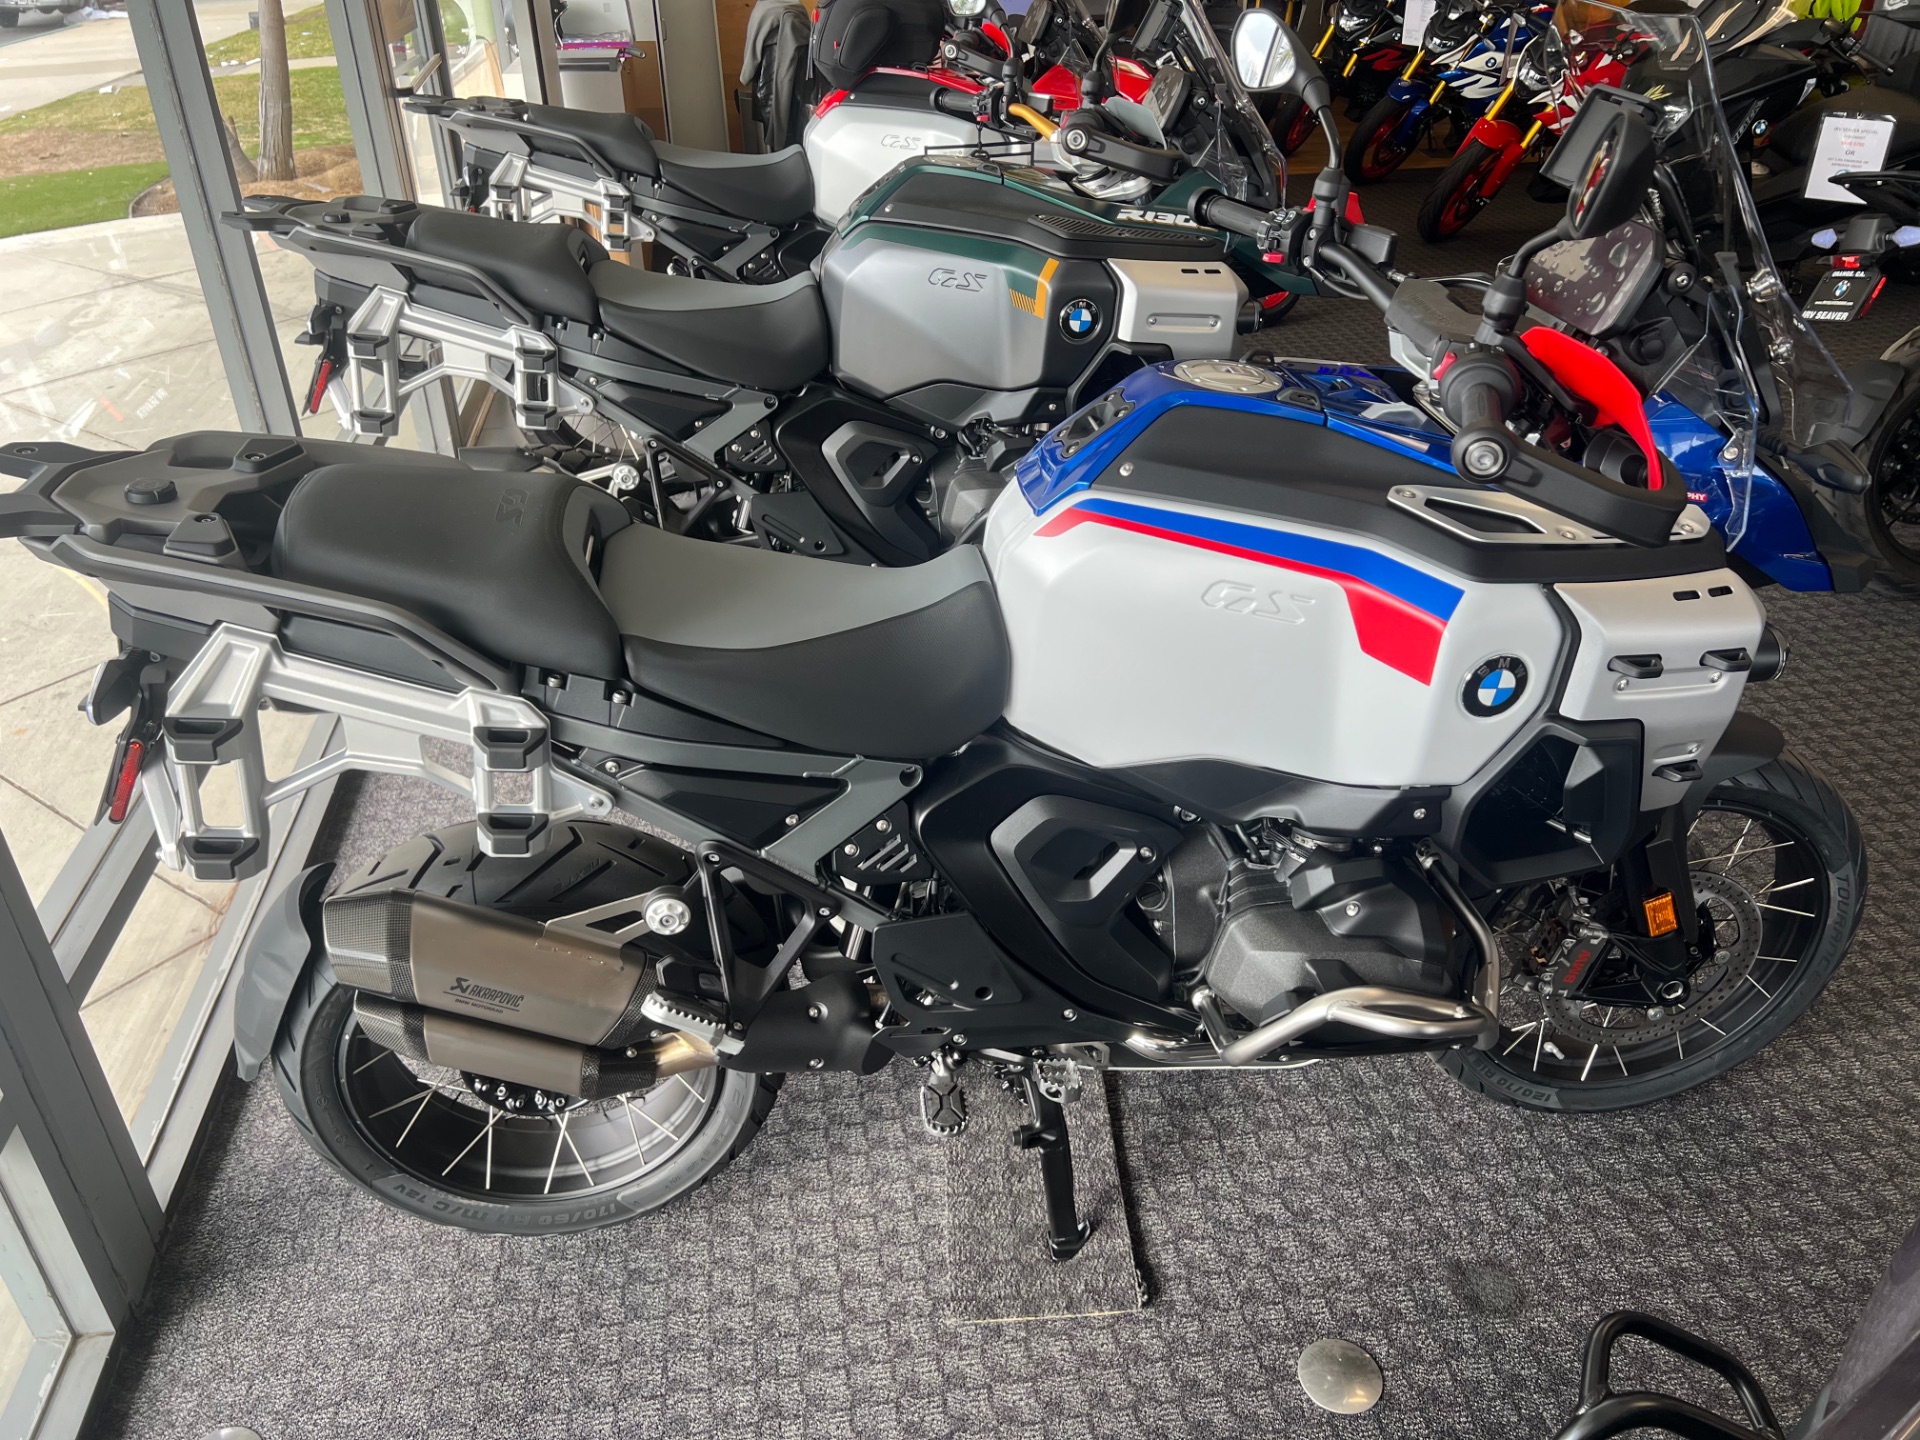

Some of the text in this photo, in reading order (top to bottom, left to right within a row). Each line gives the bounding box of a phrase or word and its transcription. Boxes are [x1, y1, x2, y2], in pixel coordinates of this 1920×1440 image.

[881, 134, 921, 151] GS
[928, 267, 988, 292] GS
[1066, 301, 1097, 314] BMW
[1815, 311, 1849, 320] SEAVER
[1201, 579, 1316, 624] GS
[1477, 657, 1526, 679] BMW
[1563, 950, 1591, 983] BMW
[454, 998, 504, 1014] BMW MOTORRAD
[1497, 1079, 1552, 1103] 120/70
[538, 1202, 617, 1227] 170/60
